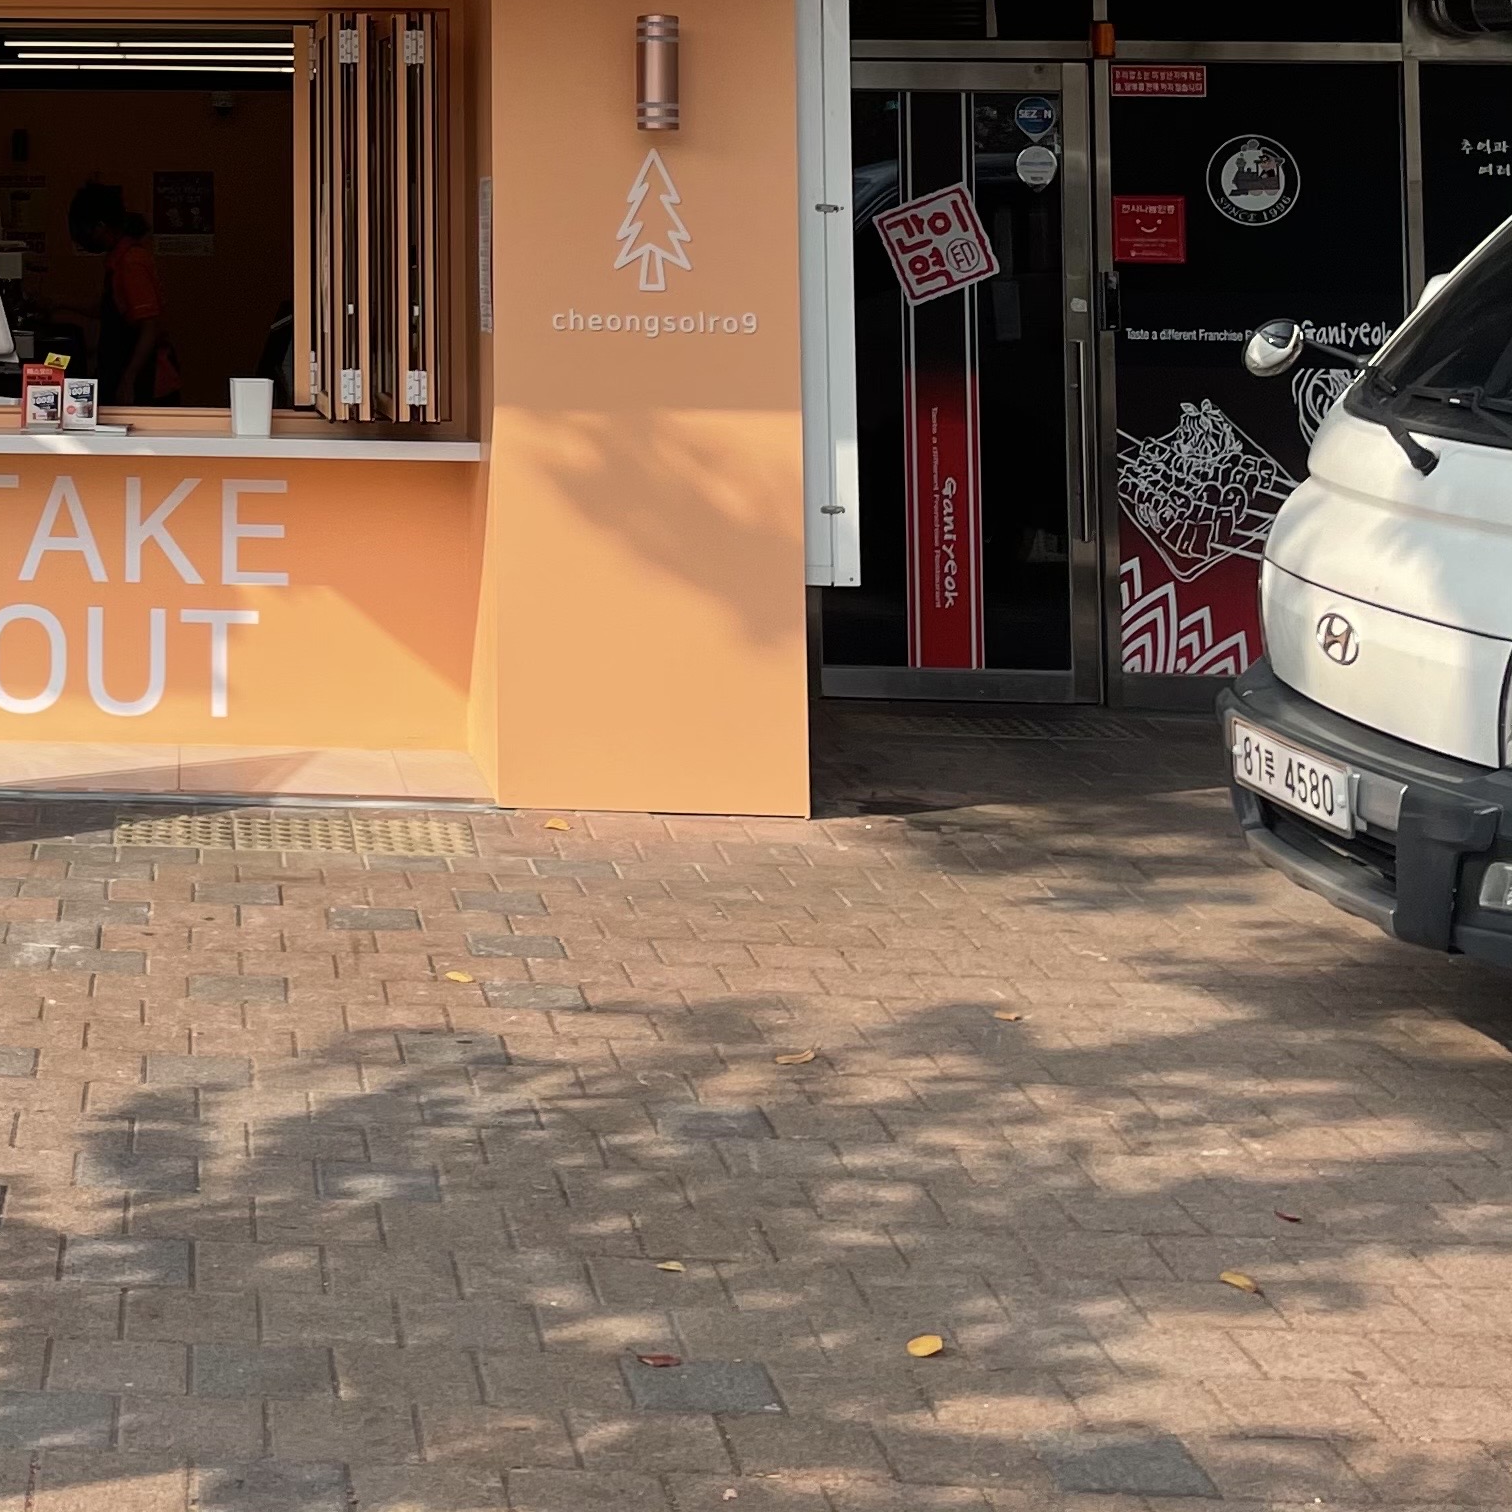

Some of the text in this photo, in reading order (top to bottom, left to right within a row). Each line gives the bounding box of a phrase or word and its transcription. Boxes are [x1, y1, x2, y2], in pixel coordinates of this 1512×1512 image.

[552, 308, 759, 338] cheongsolro9
[1125, 328, 1149, 340] Taste
[1160, 328, 1197, 341] different
[1199, 329, 1243, 342] Franchise
[1285, 757, 1334, 816] 4580
